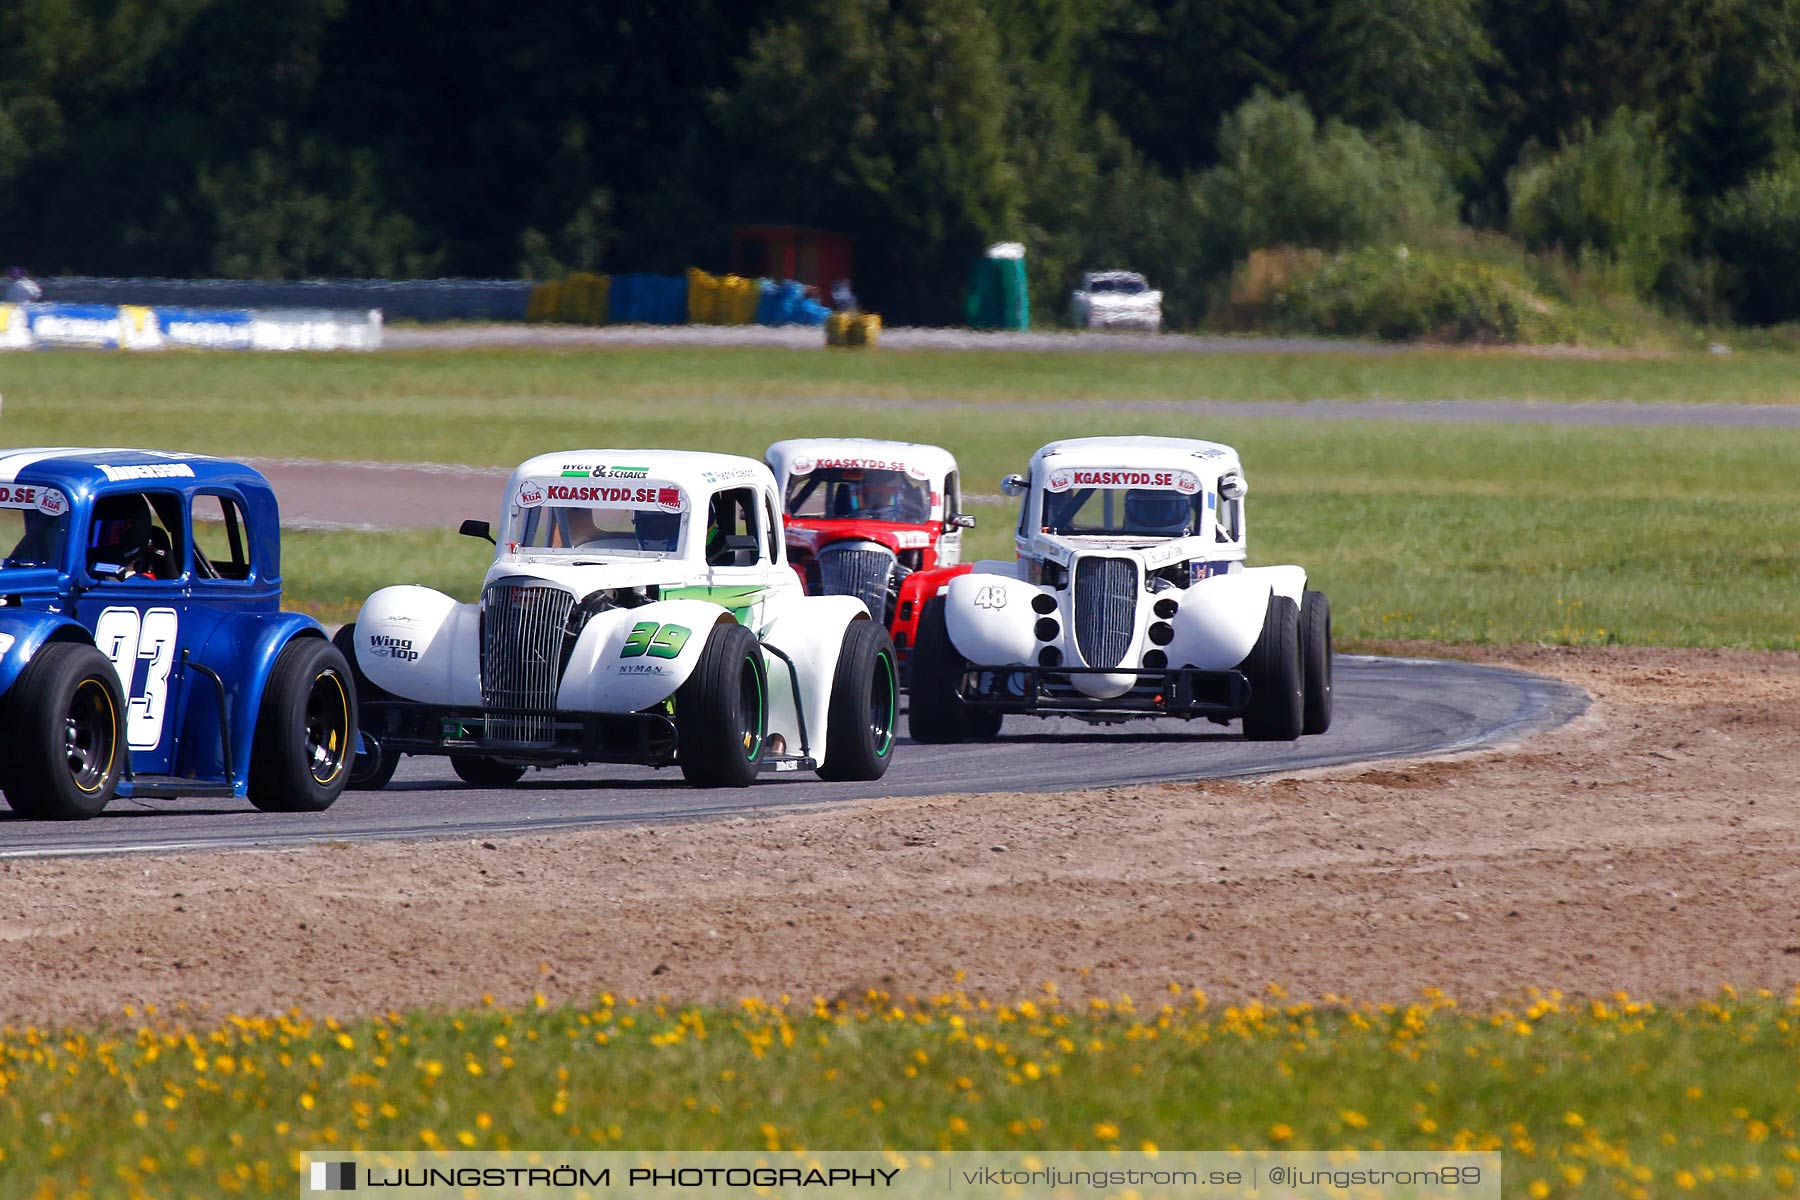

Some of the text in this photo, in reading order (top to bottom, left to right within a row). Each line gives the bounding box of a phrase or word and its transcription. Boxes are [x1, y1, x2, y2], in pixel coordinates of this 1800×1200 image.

[592, 464, 607, 478] &
[816, 458, 905, 471] KGASKYDD.SE
[1074, 472, 1173, 486] KGASKYDD.SE
[522, 491, 542, 503] KGA
[547, 485, 656, 503] KGASKYDD.SE
[41, 496, 61, 511] KGA
[974, 586, 1007, 609] 48
[370, 635, 413, 650] Wing
[620, 621, 692, 660] 39
[388, 646, 419, 662] Top
[619, 665, 663, 673] NYMAN
[95, 606, 178, 751] 93
